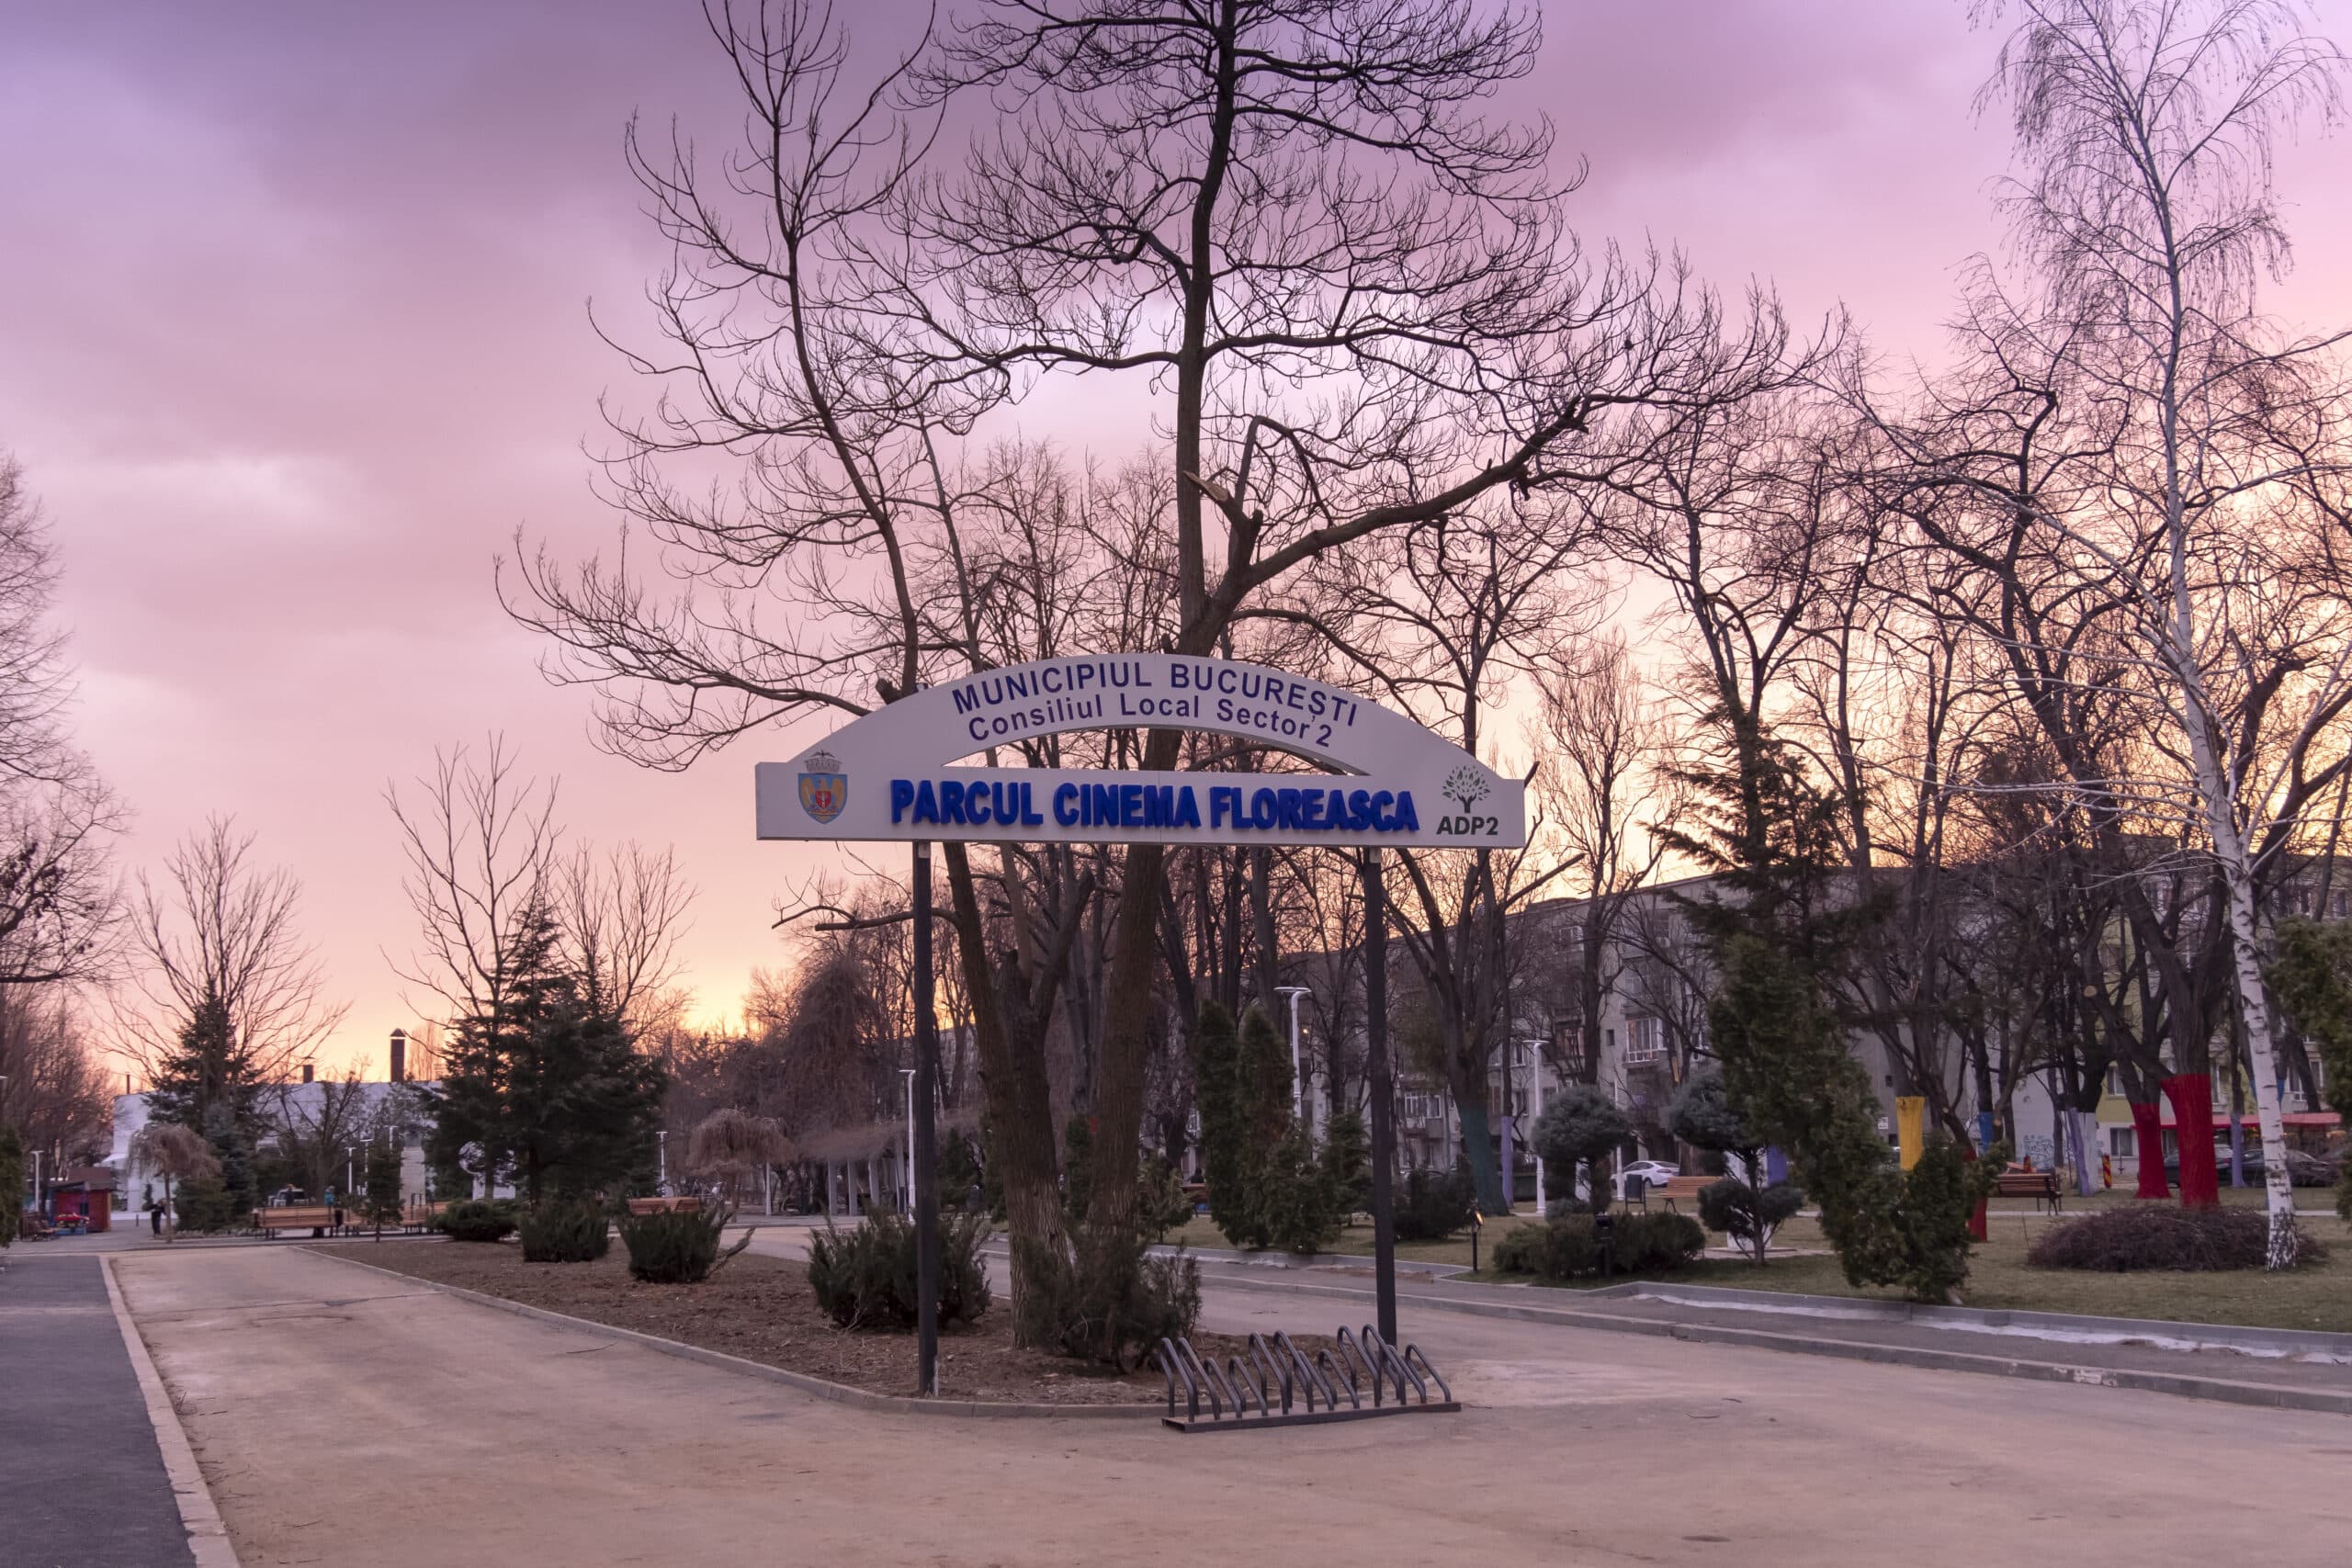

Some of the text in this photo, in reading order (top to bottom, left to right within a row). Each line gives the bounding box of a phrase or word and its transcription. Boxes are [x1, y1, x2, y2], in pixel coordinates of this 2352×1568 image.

[952, 661, 1152, 715] MUNICIPIUL
[968, 693, 1332, 748] Consiliul Local Sector 2
[890, 779, 1420, 832] PARCUL CINEMA FLOREASCA
[1436, 815, 1498, 835] ADP2
